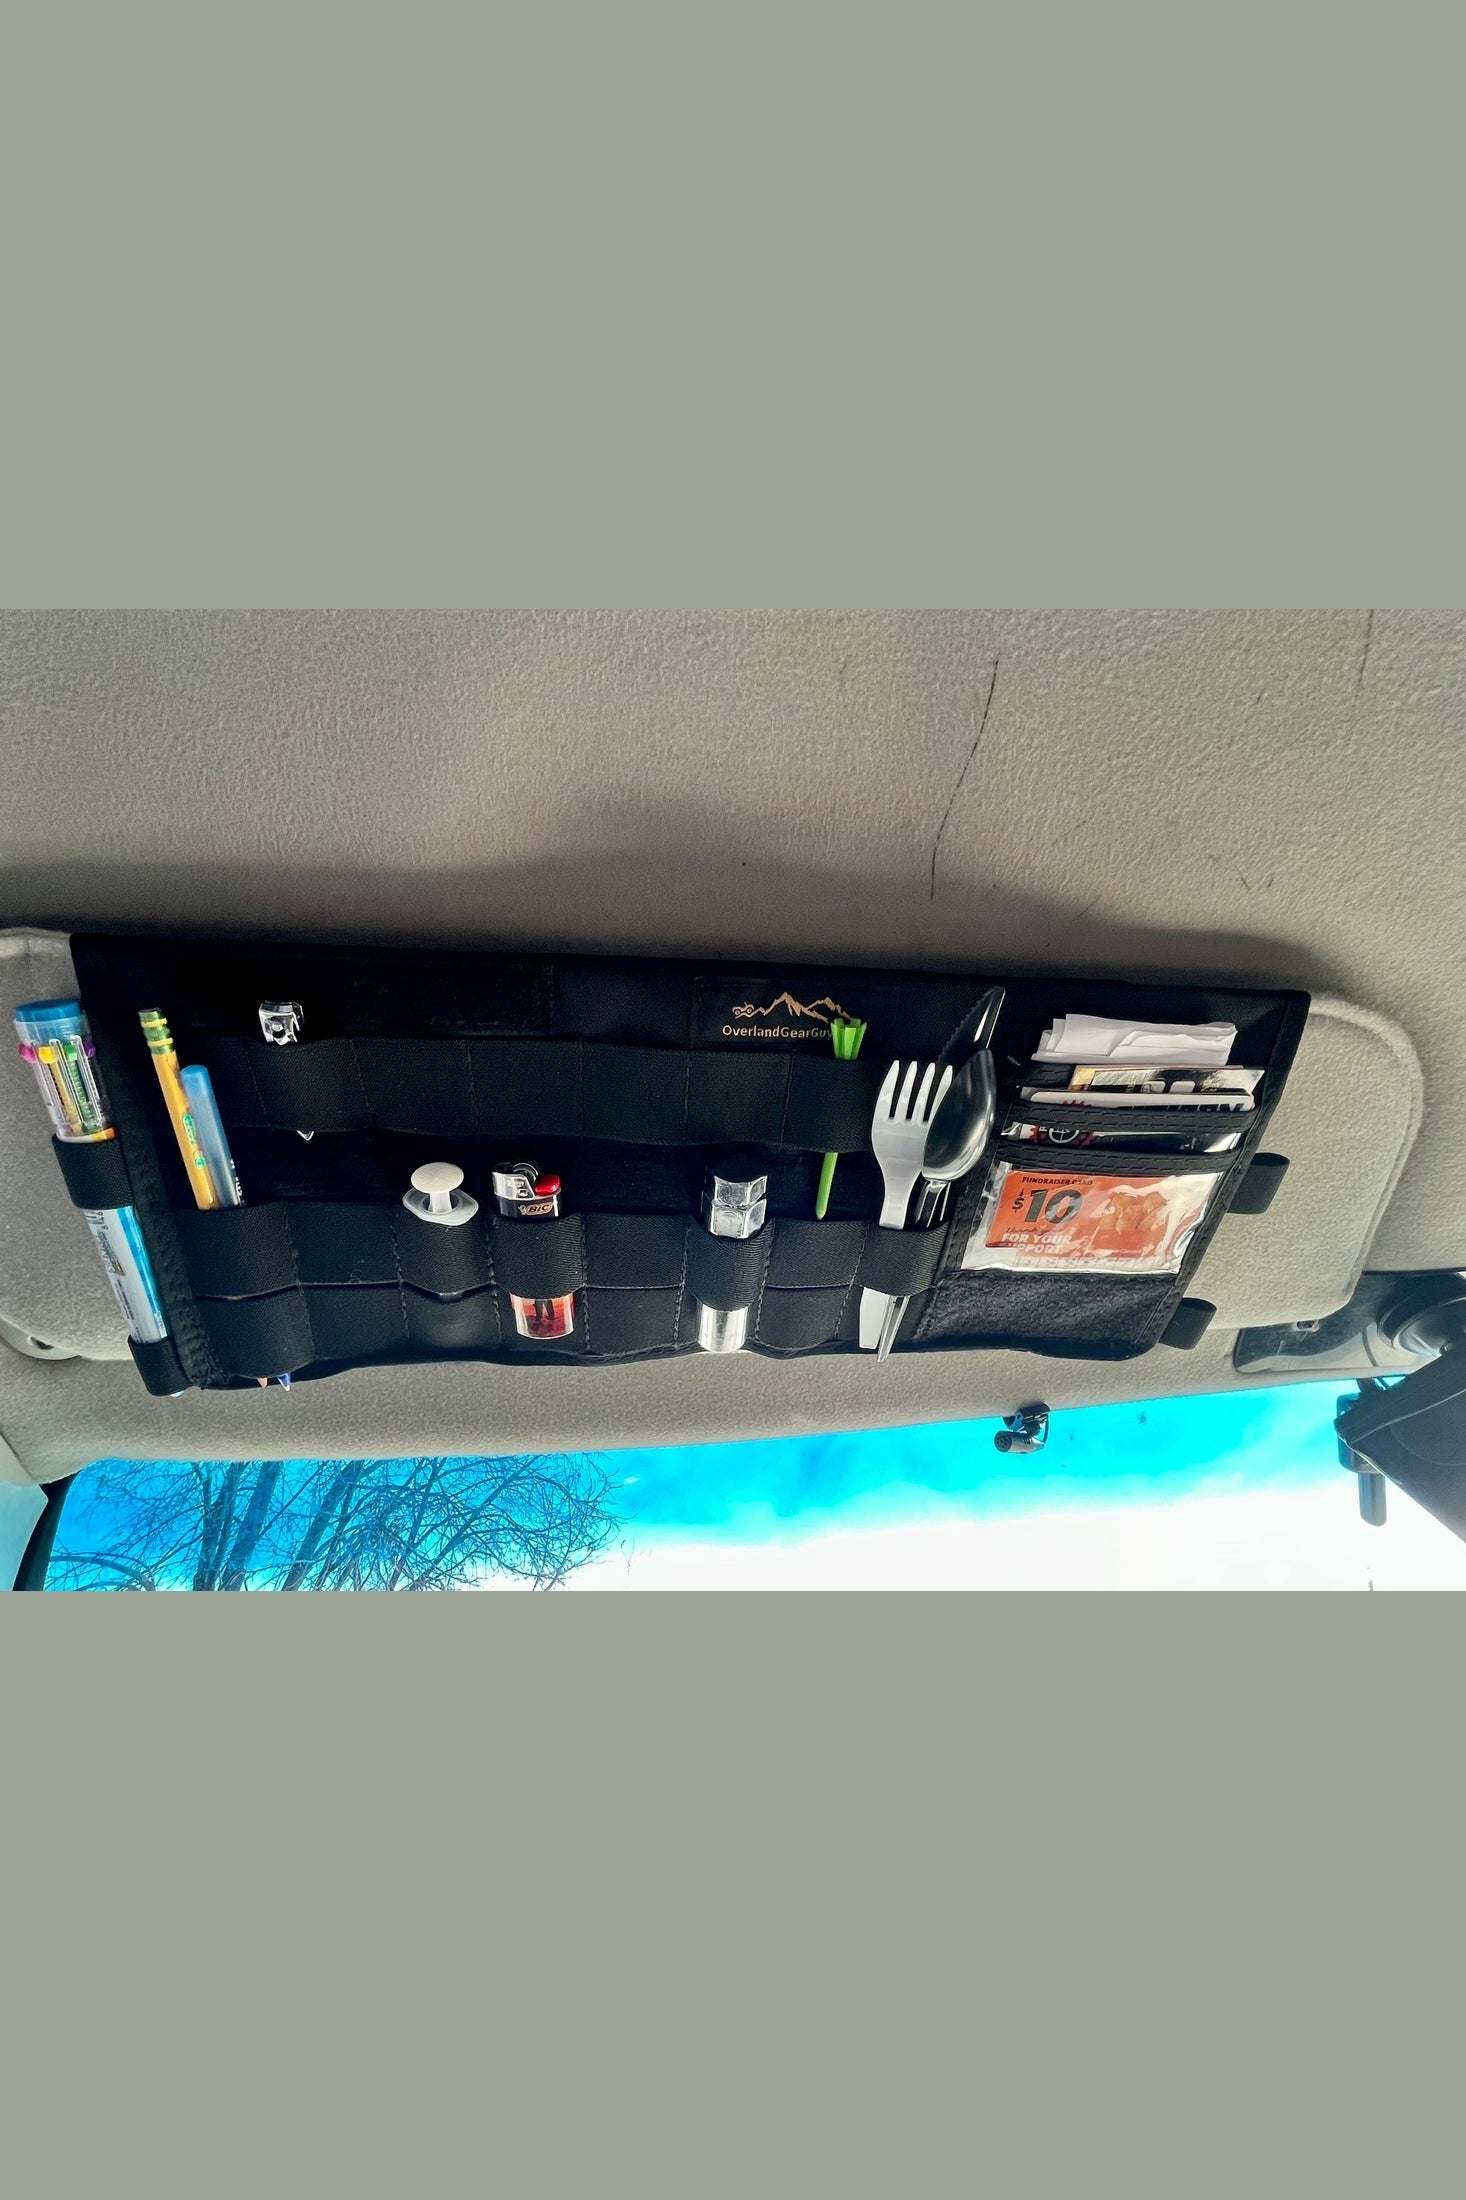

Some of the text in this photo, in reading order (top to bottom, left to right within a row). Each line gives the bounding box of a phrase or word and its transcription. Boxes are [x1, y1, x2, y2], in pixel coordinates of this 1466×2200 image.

[1021, 1176, 1071, 1185] FUNDRAISER
[1012, 1189, 1083, 1225] $10
[1001, 1231, 1030, 1243] FOR
[1033, 1232, 1073, 1245] YOUR
